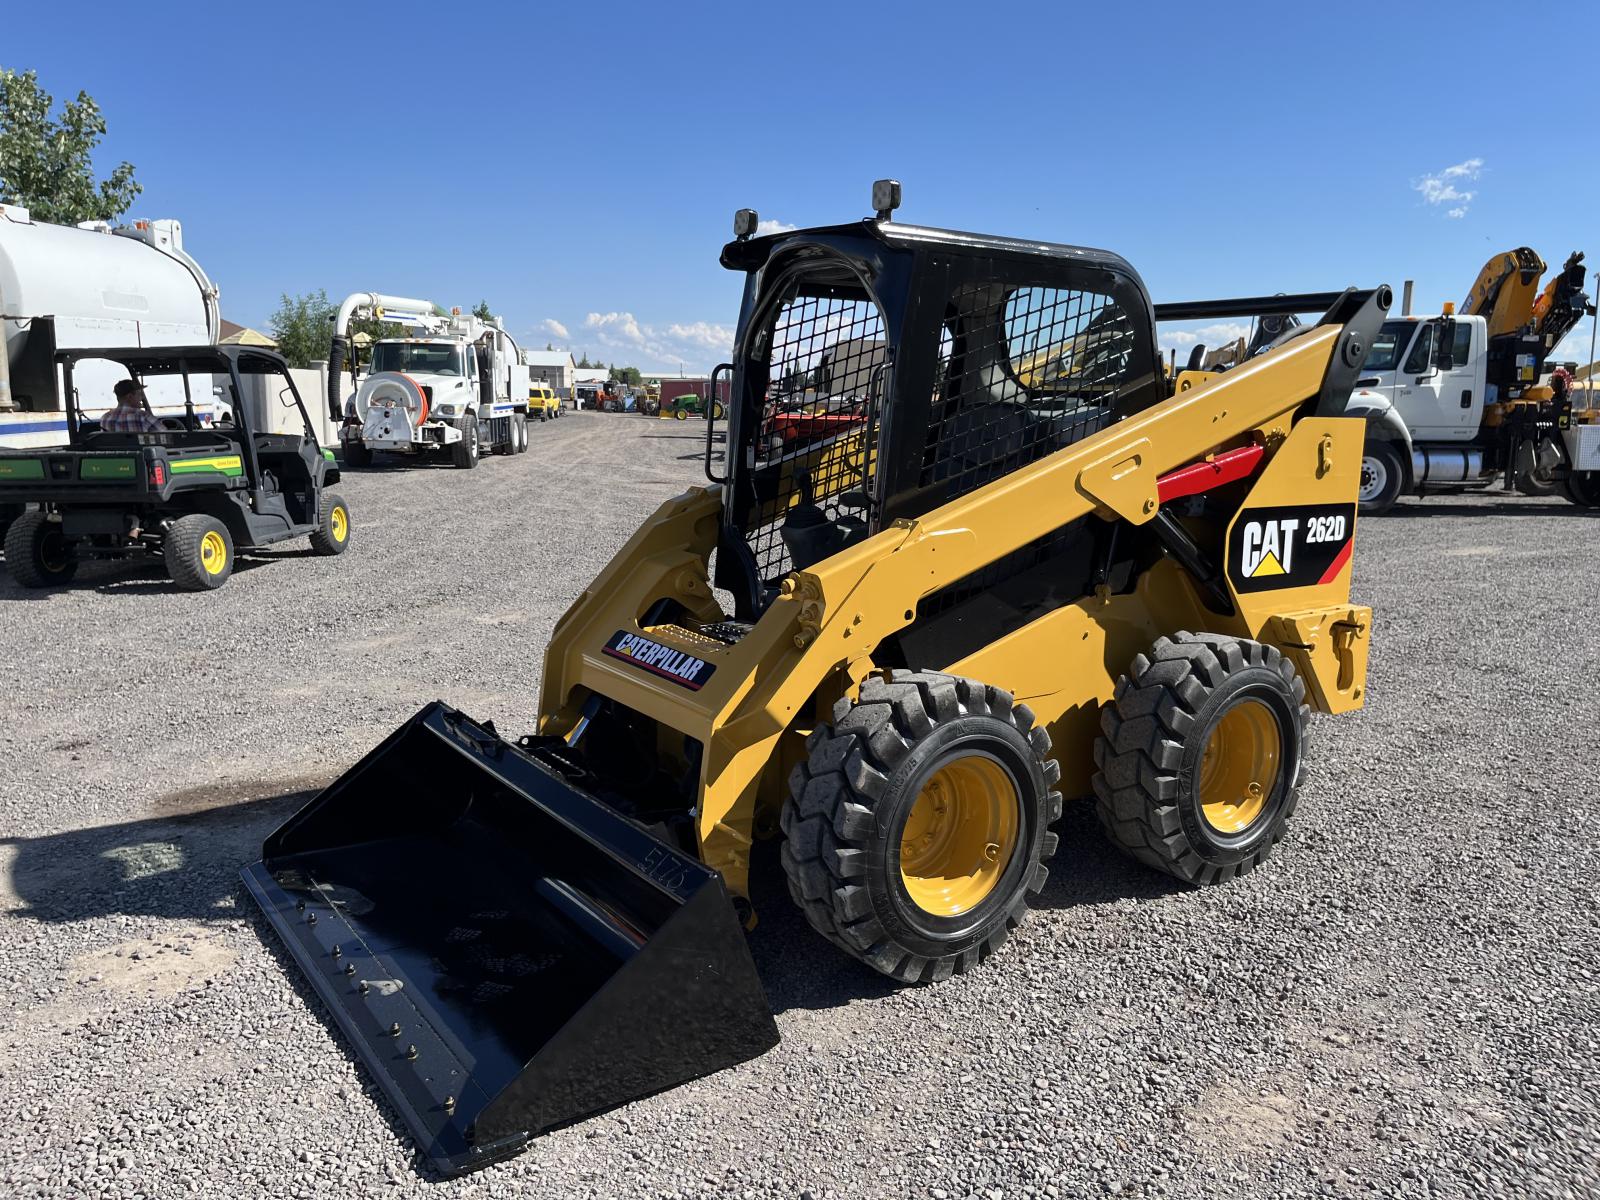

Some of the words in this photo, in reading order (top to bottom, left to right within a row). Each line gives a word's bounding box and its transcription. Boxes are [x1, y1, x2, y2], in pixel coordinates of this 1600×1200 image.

[1241, 519, 1299, 578] CAT
[1305, 515, 1346, 543] 262D
[615, 633, 704, 681] CATERPILLAR
